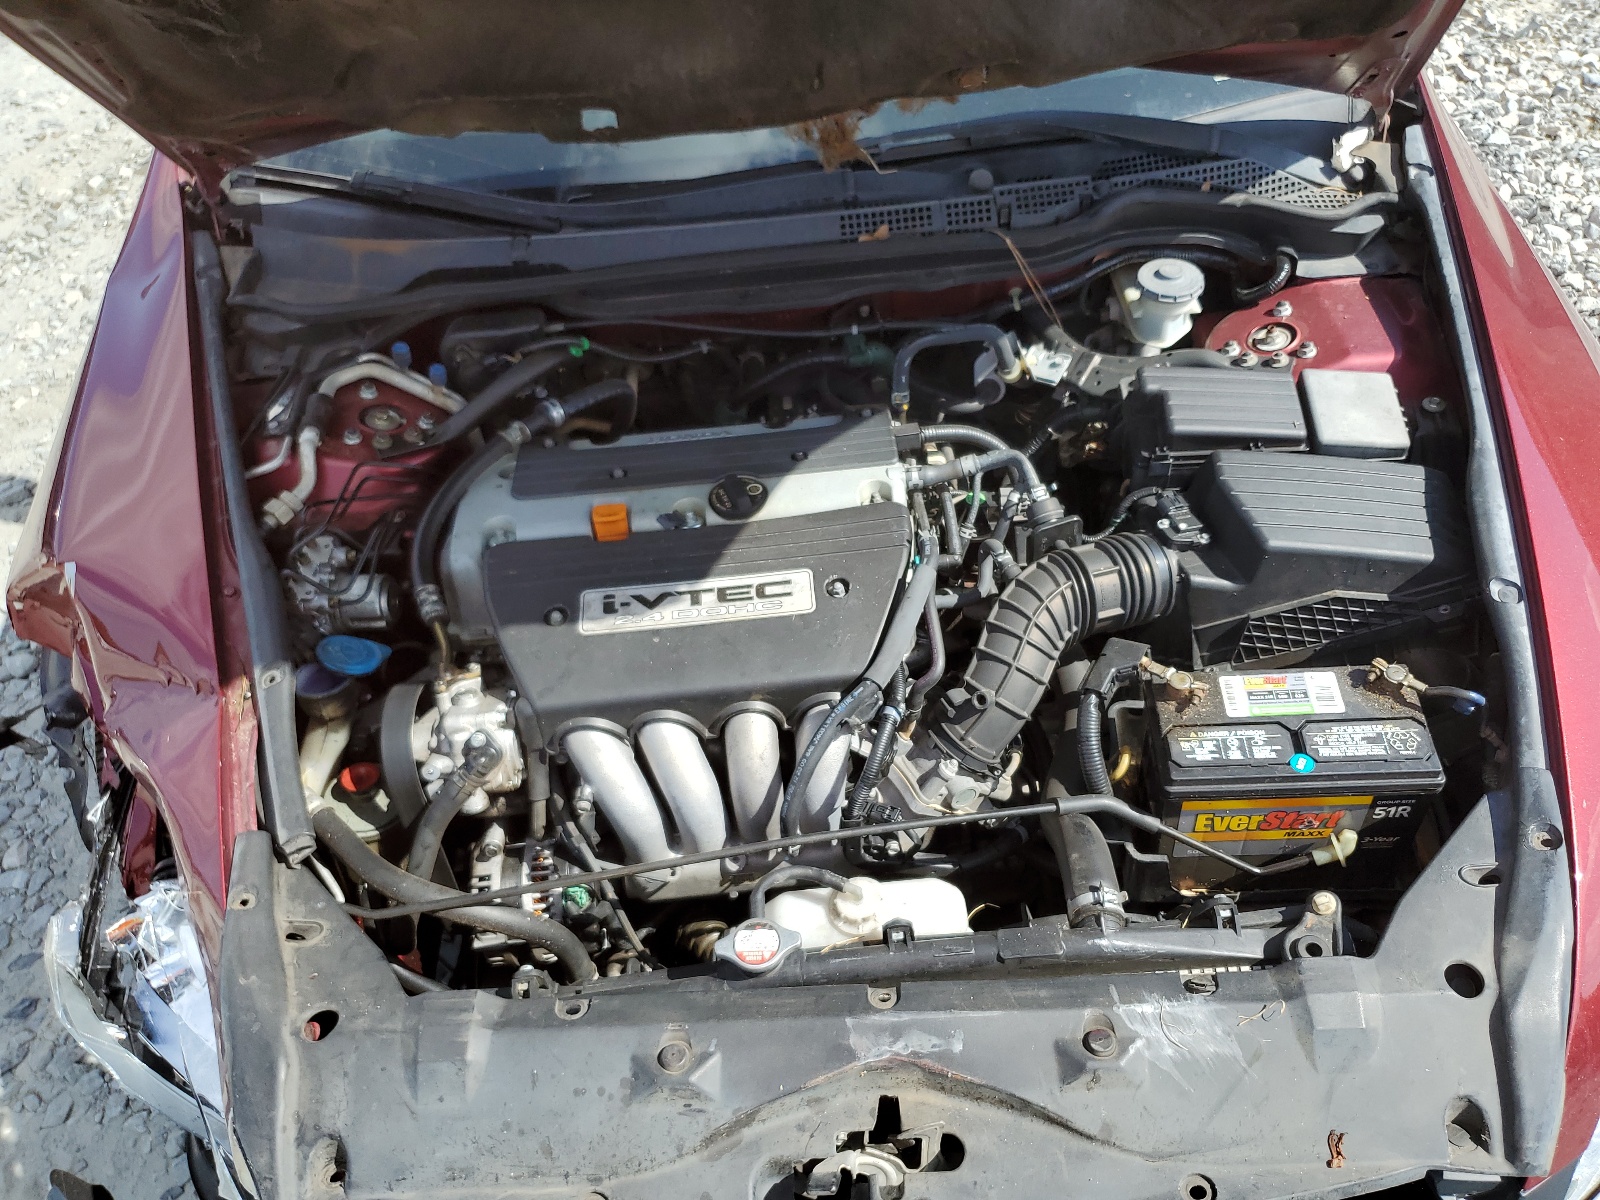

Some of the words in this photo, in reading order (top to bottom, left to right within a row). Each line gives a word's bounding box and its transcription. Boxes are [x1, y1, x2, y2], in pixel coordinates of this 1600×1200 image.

[602, 579, 793, 614] i-VTEC
[613, 611, 665, 625] 2.4
[671, 600, 783, 620] DOHC
[1194, 810, 1346, 833] EverStart
[1372, 806, 1411, 819] 51R
